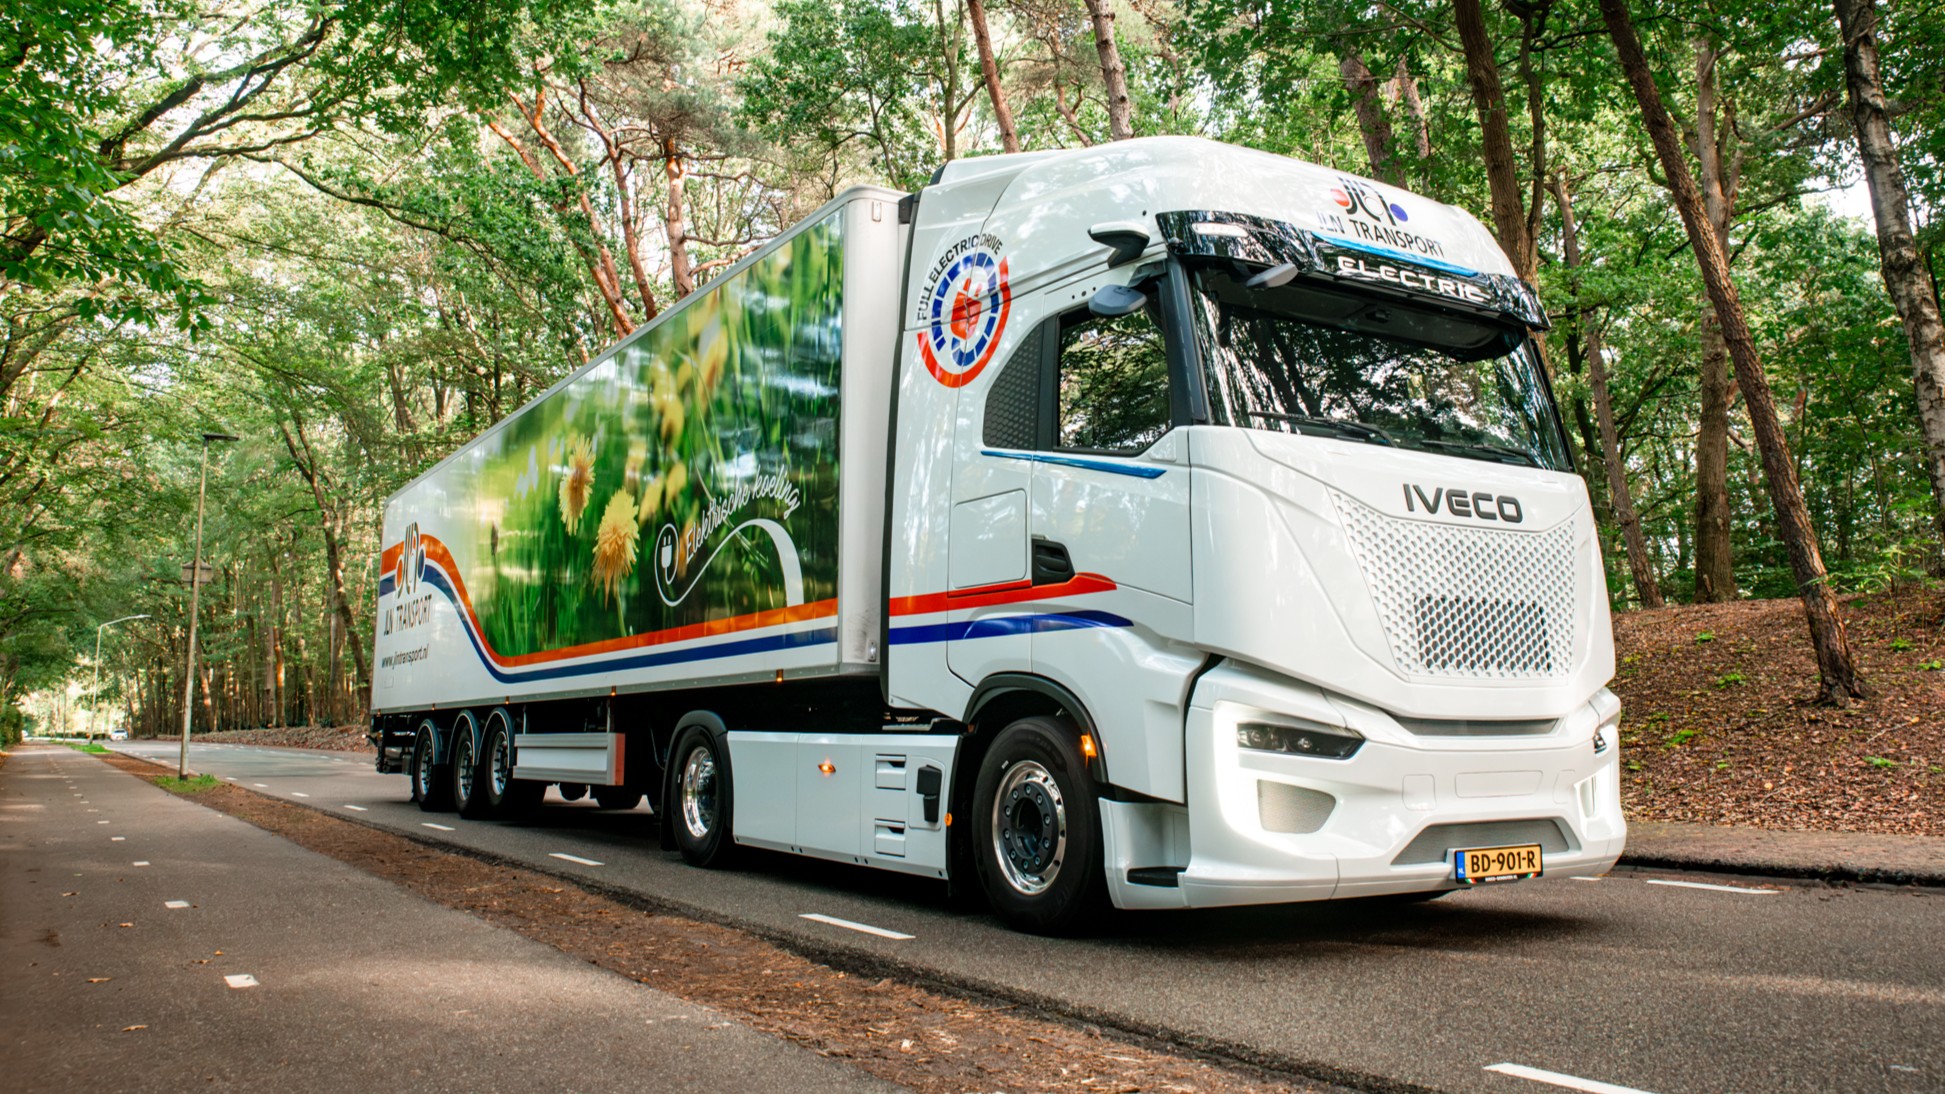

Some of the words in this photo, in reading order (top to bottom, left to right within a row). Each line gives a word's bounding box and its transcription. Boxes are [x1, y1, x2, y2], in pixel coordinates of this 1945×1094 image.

[1348, 218, 1445, 258] TRANSPORT
[917, 283, 935, 321] FULL
[931, 234, 980, 284] ELECTRIC
[979, 233, 1003, 256] DRIVE
[1338, 257, 1491, 302] ELECTRIC
[686, 478, 751, 565] Elektrische
[752, 463, 801, 520] koeling
[1402, 483, 1523, 524] IVECO
[396, 594, 432, 631] TRANSPORT
[1471, 851, 1535, 873] BD-901-R
